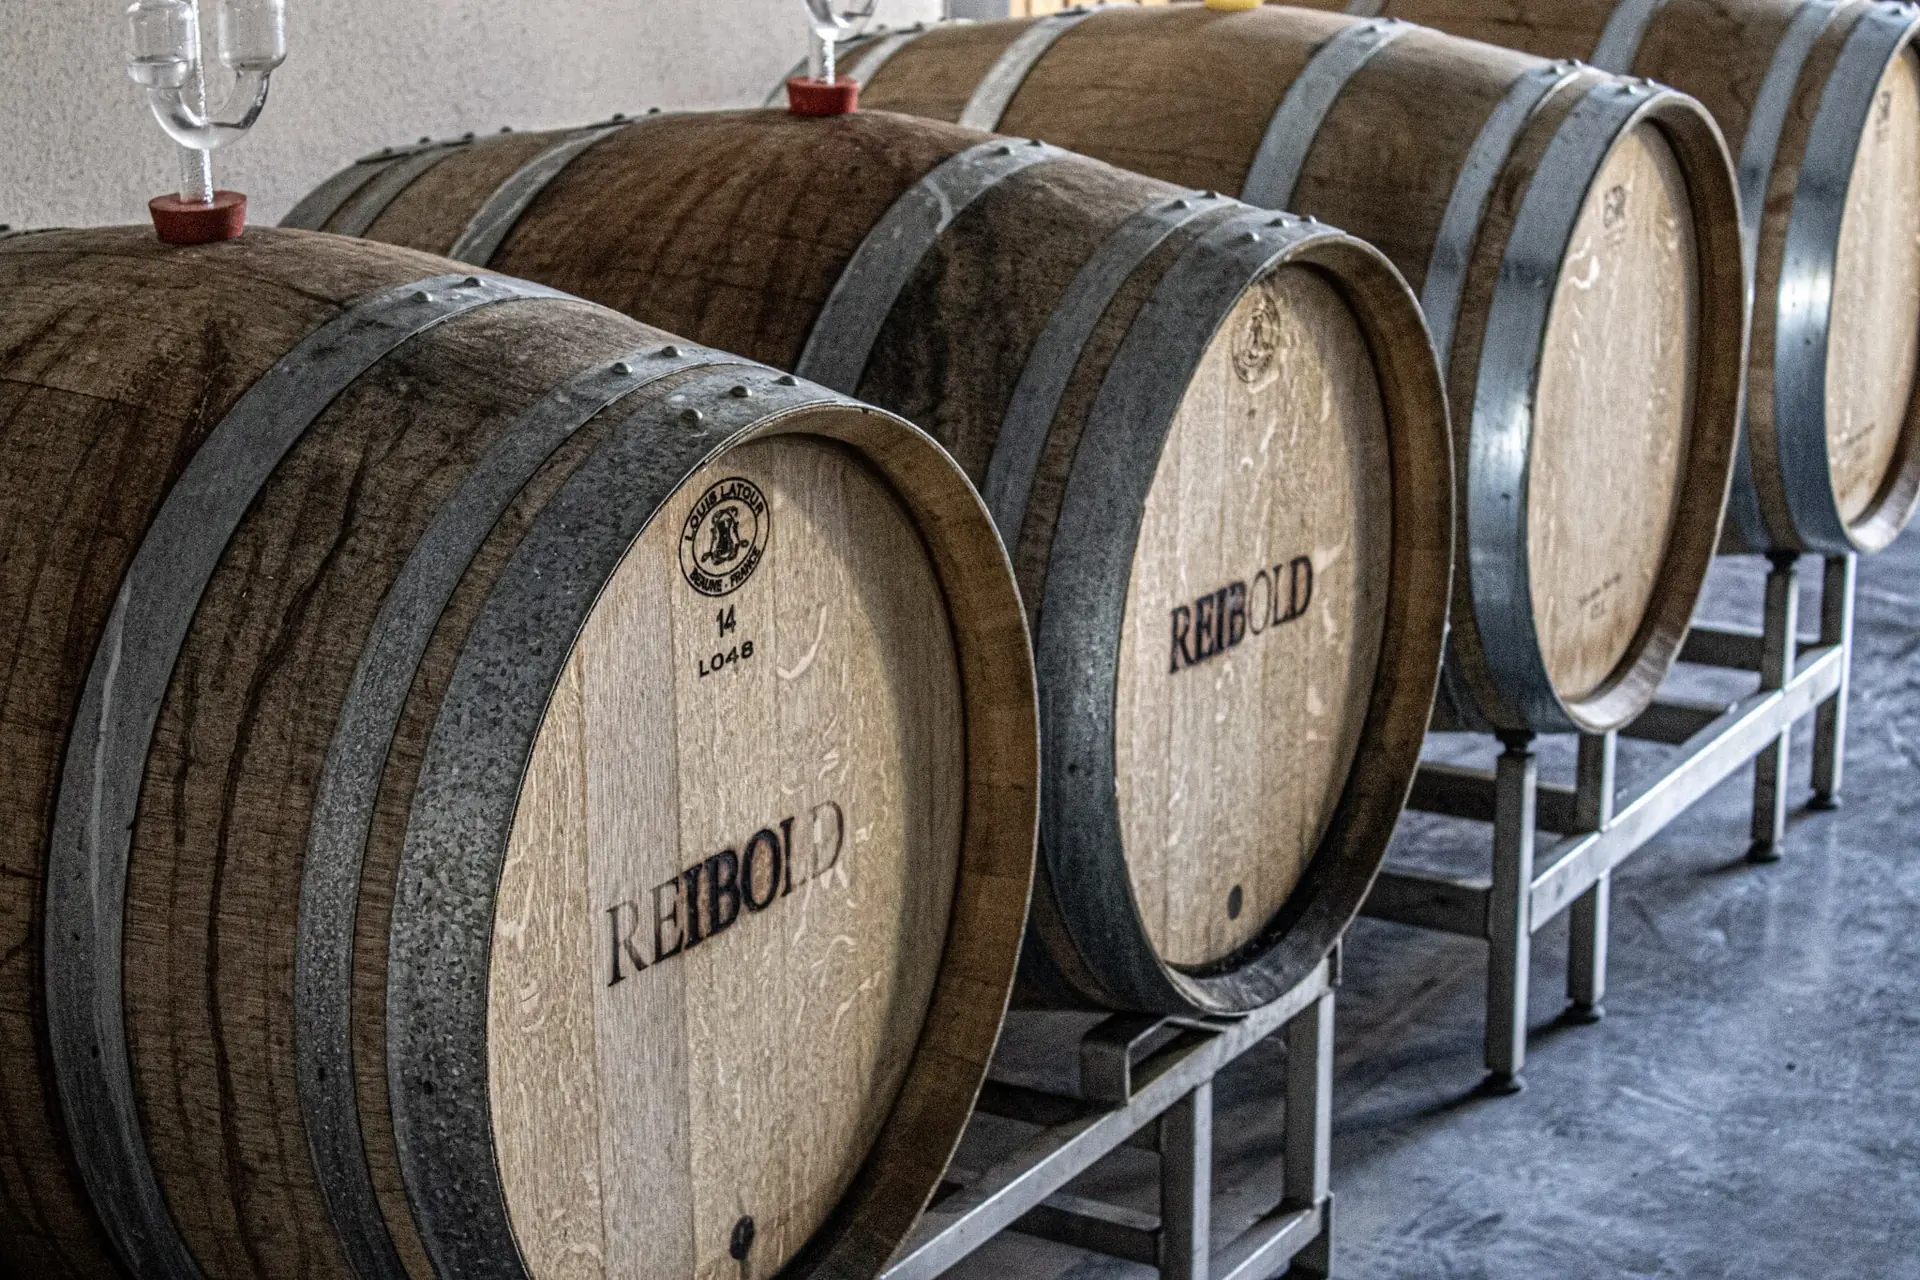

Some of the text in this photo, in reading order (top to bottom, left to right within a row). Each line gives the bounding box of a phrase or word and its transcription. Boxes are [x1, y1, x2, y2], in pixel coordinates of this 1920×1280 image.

[685, 482, 764, 541] LOUIS LATOUR
[690, 545, 761, 593] BEAUNE FRANCE
[716, 604, 736, 638] 14
[1169, 555, 1313, 674] REIBOLD
[606, 800, 844, 988] REIBOLD
